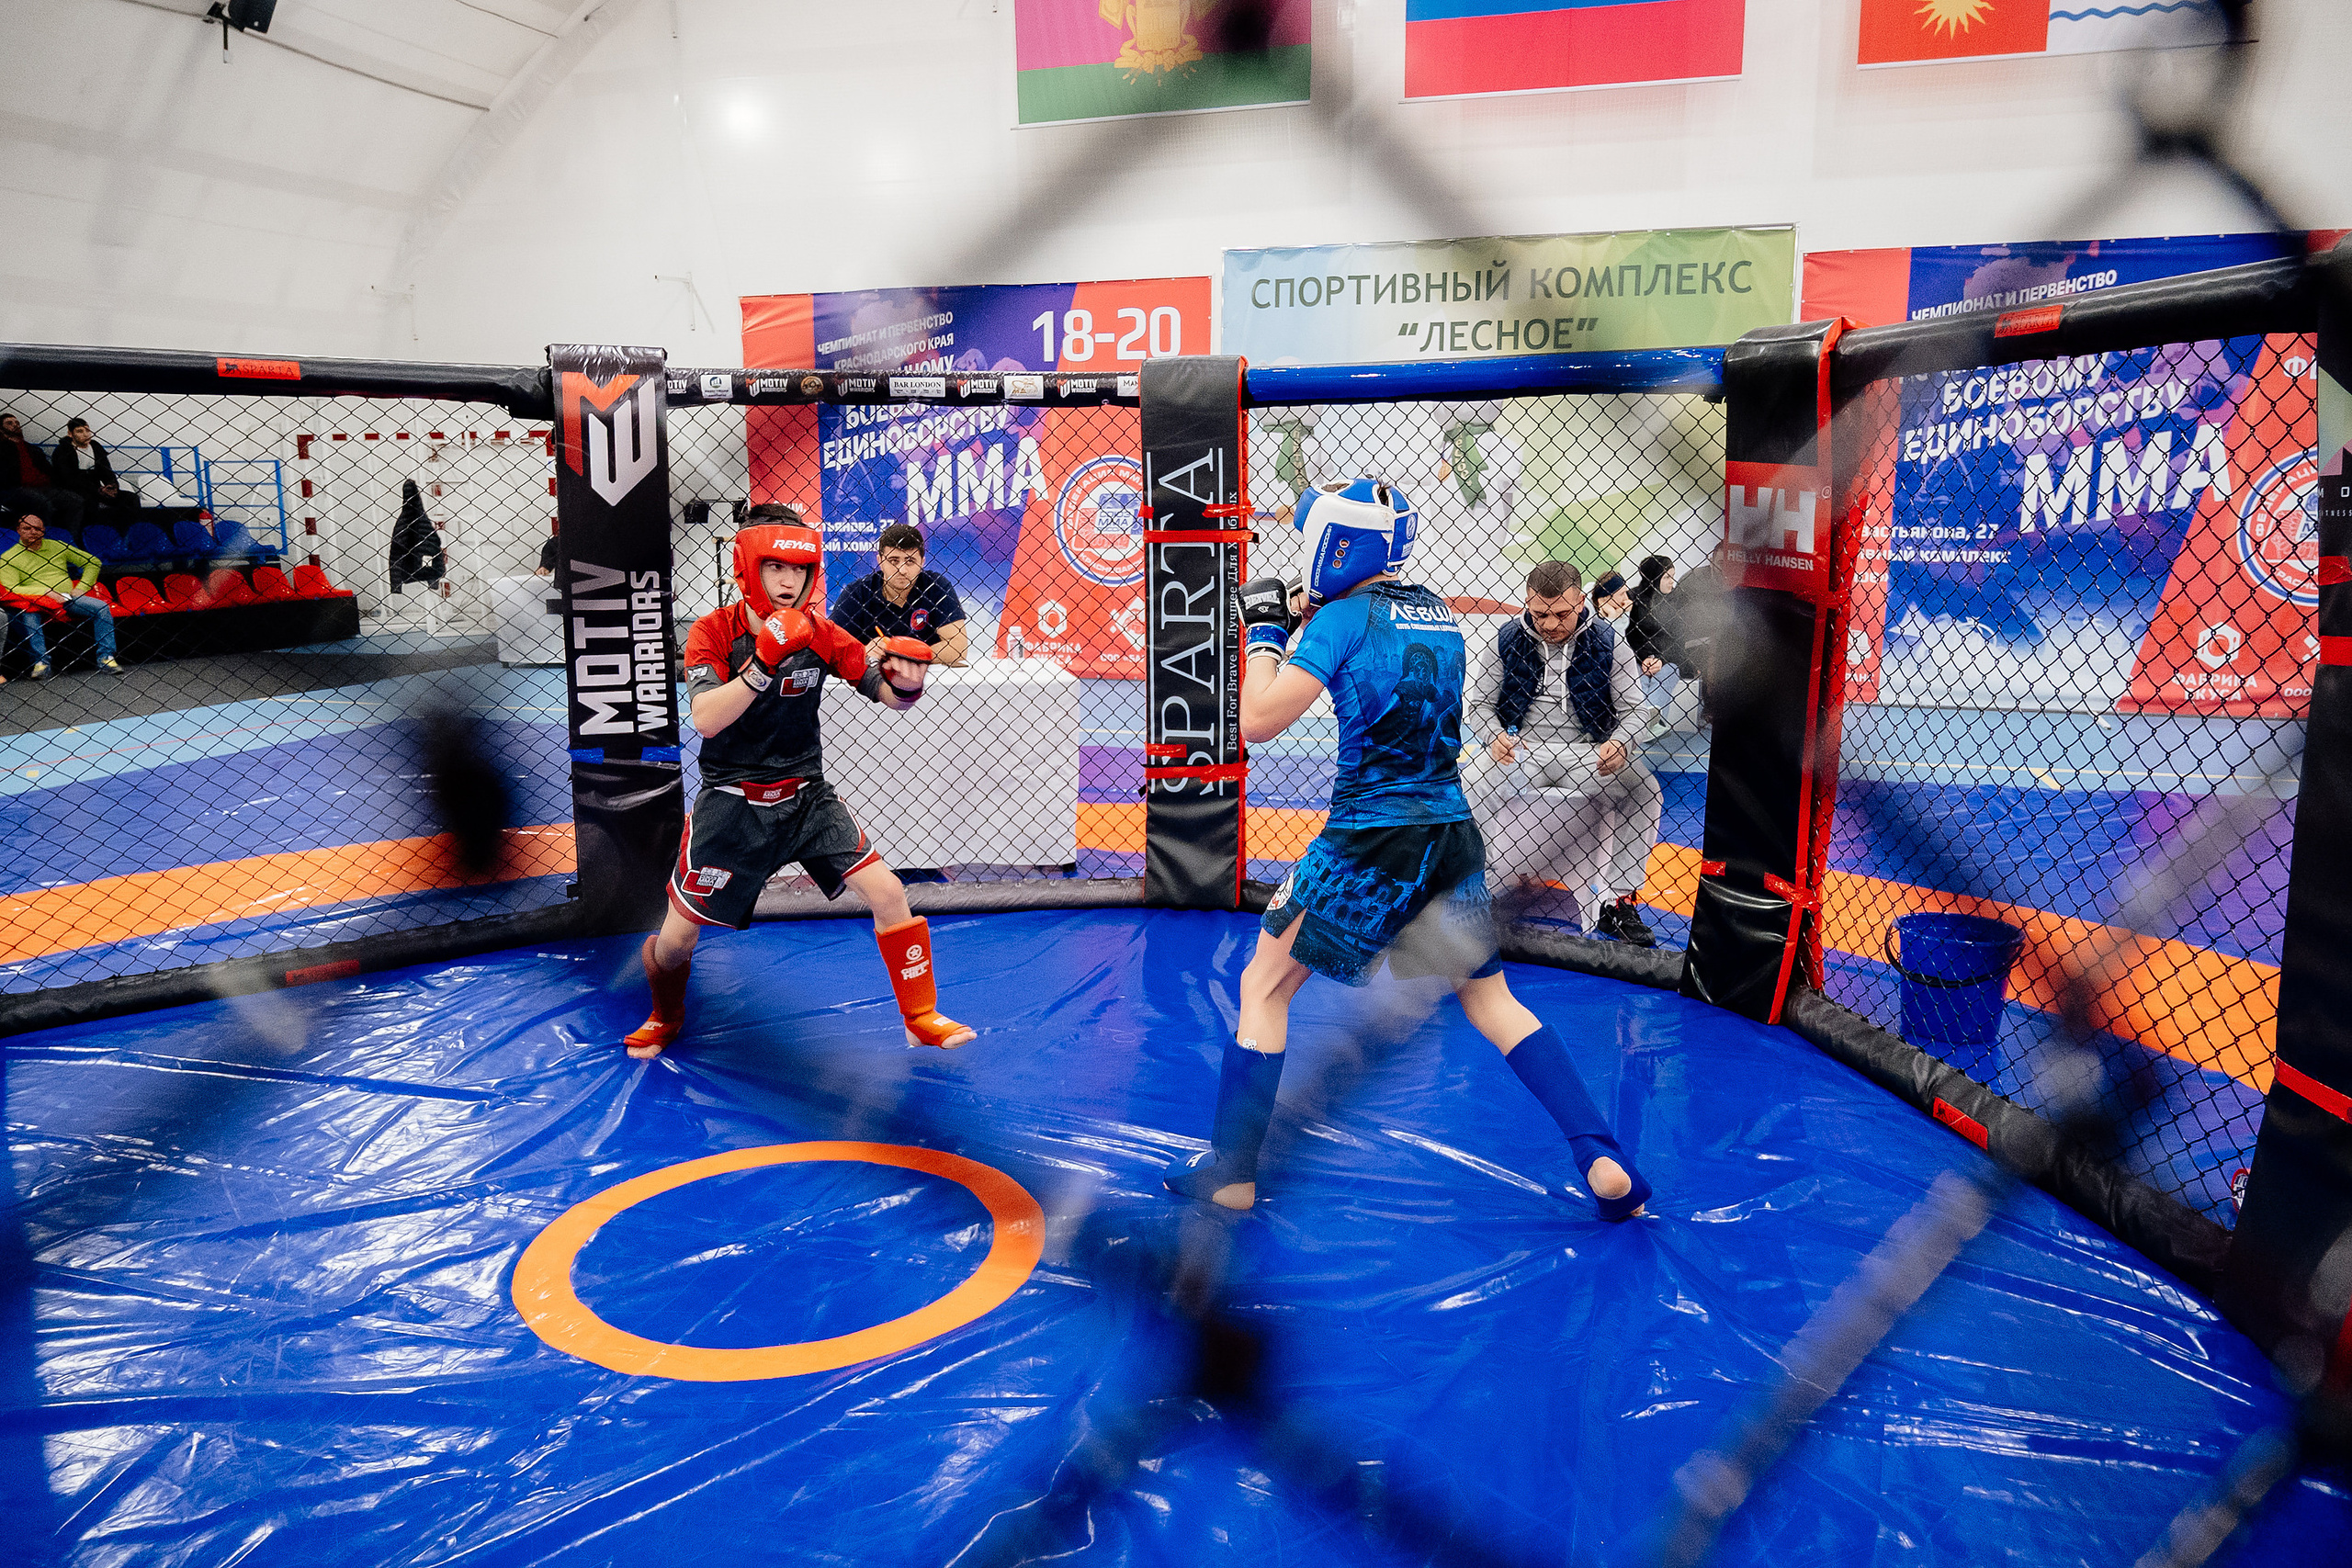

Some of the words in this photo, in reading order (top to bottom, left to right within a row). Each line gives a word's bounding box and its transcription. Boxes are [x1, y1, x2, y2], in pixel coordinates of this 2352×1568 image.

[1251, 259, 1510, 310] СПОРТИВНЫЙ
[1530, 261, 1753, 299] КОМПЛЕКС
[2005, 291, 2018, 307] И
[2019, 269, 2118, 304] ПЕРВЕНСТВО
[817, 329, 877, 355] ЧЕМПИОНАТ
[879, 327, 888, 339] И
[888, 310, 954, 337] ПЕРВЕНСТВО
[927, 333, 955, 351] КРАЯ
[1032, 306, 1182, 362] 18-20
[243, 364, 295, 377] SPARTA
[760, 378, 789, 389] MOTIV
[848, 378, 876, 388] MOTIV
[971, 378, 999, 389] MOTIV
[1070, 378, 1098, 389] MOTIV
[1942, 354, 2110, 414] БОЕВОМУ
[823, 405, 1009, 471] ЕДИНОБОРСТВУ
[1903, 378, 2190, 466] ЕДИНОБОРСТВУ
[907, 436, 1049, 528] ММА
[2018, 421, 2233, 534] ММА
[1974, 523, 2000, 540] 27
[1227, 555, 1240, 582] Для
[1727, 550, 1762, 564] HELLY
[1764, 555, 1815, 571] HANSEN
[1919, 550, 2012, 564] комплекс
[1158, 447, 1216, 796] SPARTA
[1227, 585, 1238, 639] Лучшее
[569, 558, 635, 736] MOTIV
[630, 570, 669, 734] WARRIORS
[1023, 641, 1083, 655] ФАБРИКА
[1227, 654, 1238, 694] Brave
[2170, 672, 2258, 688] ФАБРИКА
[1227, 696, 1238, 719] For
[1227, 720, 1238, 751] Best
